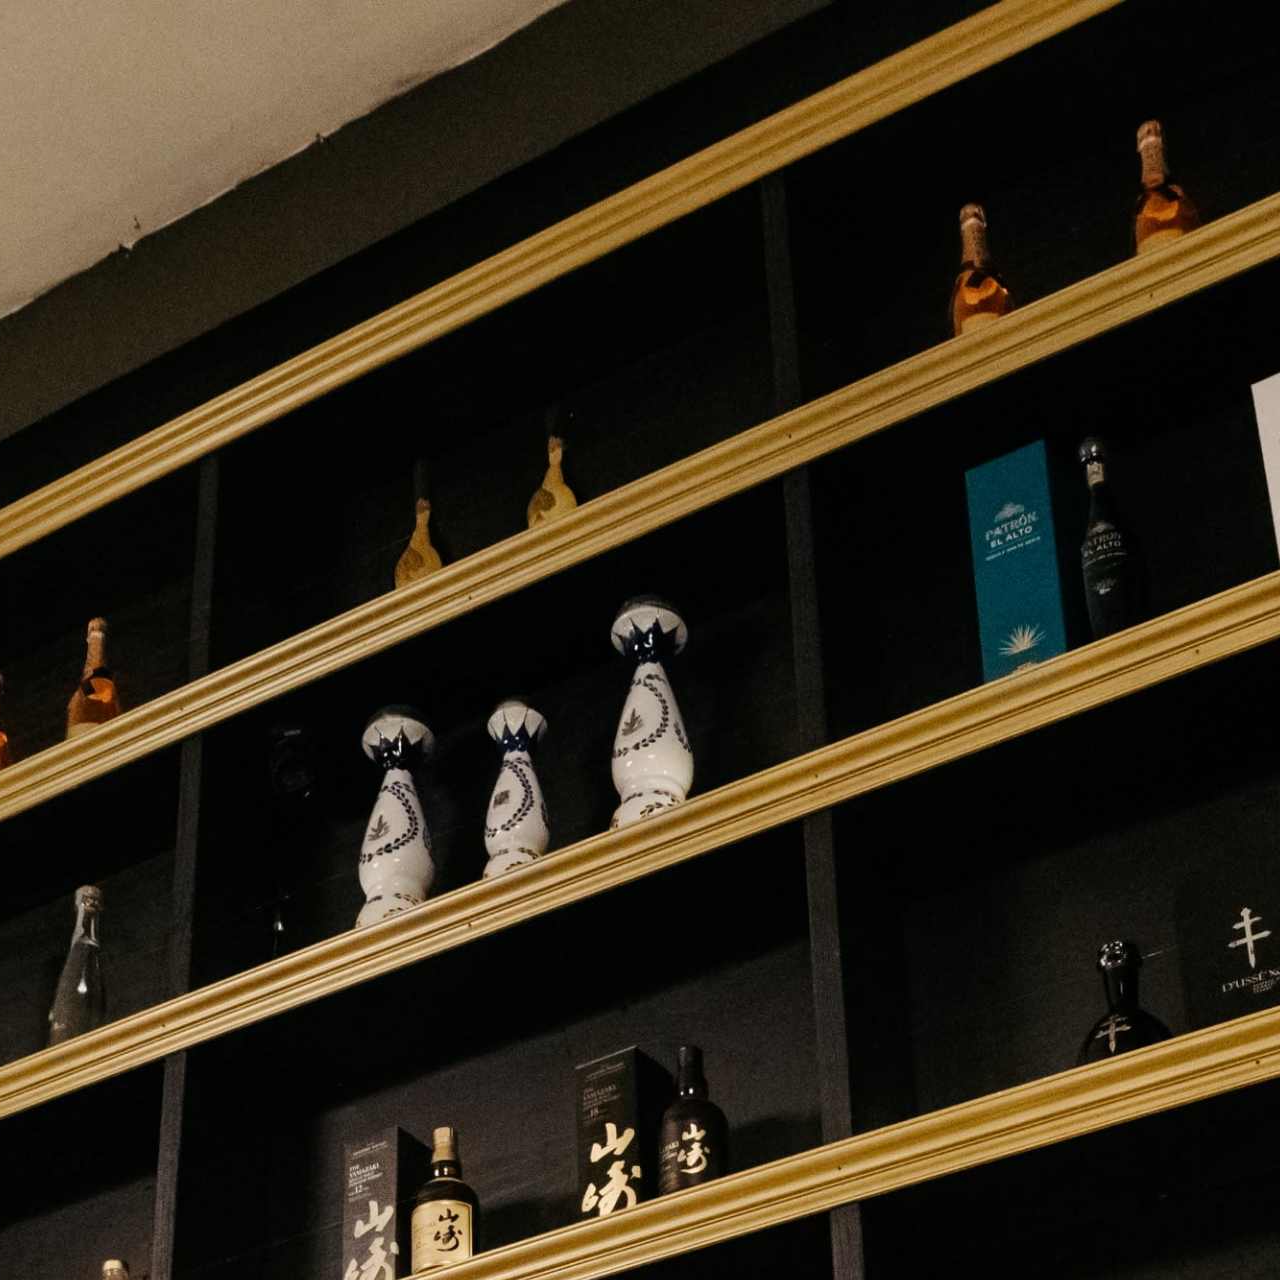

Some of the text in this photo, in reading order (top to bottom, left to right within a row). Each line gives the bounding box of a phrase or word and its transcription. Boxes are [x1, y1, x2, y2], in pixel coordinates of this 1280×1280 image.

[985, 510, 1039, 541] PATRÓN
[989, 536, 1004, 549] EL
[1005, 524, 1033, 541] ALTO
[1086, 530, 1122, 547] ATRÓN
